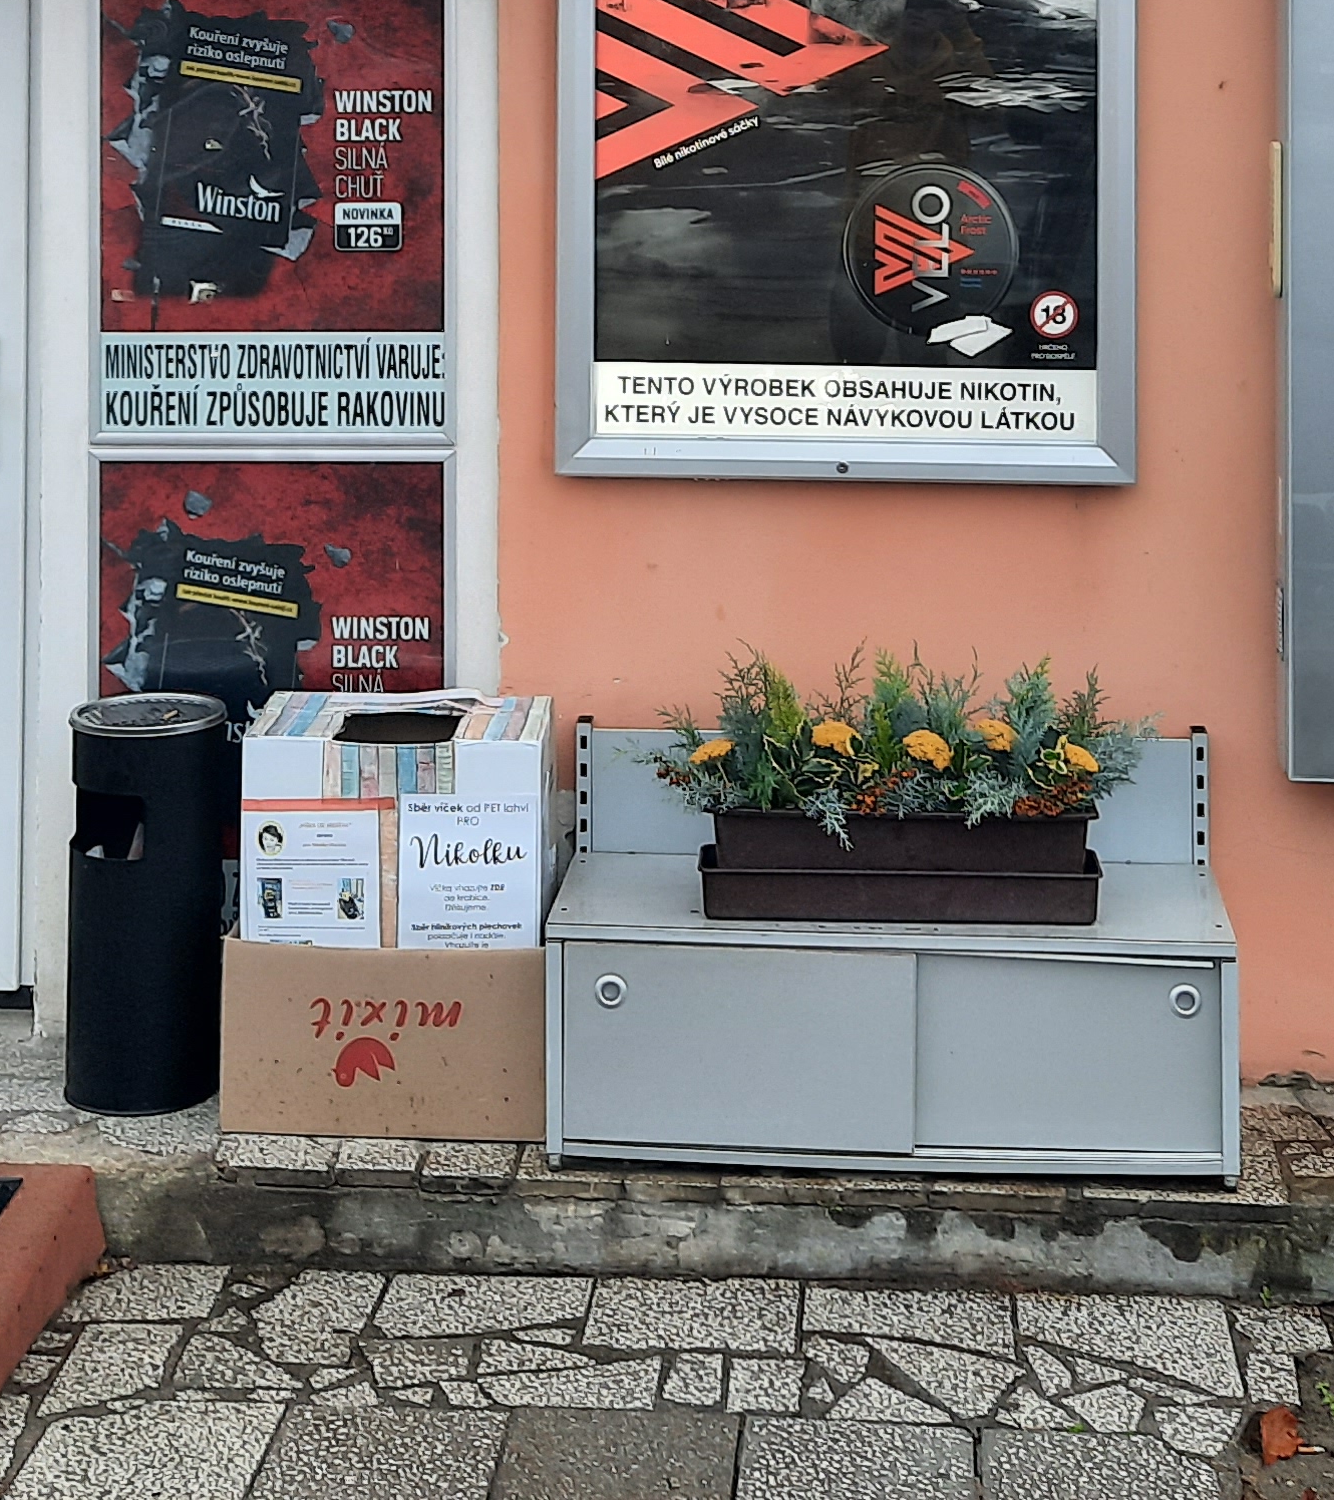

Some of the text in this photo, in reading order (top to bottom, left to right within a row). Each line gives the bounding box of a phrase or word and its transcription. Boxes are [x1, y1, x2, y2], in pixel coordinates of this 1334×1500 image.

[335, 90, 433, 113] WINSTON
[336, 118, 402, 142] BLACK
[335, 142, 388, 170] SILNÁ
[675, 127, 728, 160] nikotinové
[335, 174, 384, 199] CHUŤ
[197, 181, 280, 223] Winston
[342, 207, 394, 220] NOVINKA
[347, 226, 383, 248] 126
[1040, 304, 1067, 325] 18
[105, 337, 445, 380] MINISTERSTVO ZDRAVOTNICTVÍ VARUJE:
[617, 373, 1062, 404] TENTO VÝROBEK OBSAHUJE NIKOTIN,
[106, 382, 445, 427] KOUŘENÍ ZPŮSOBUJE RAKOVINU
[604, 399, 1075, 432] KTERÝ JE VYSOCE NÁVYKOVOU LÁTKOU
[332, 616, 429, 640] WINSTON
[332, 645, 399, 668] BLACK
[456, 816, 479, 826] PRO
[409, 833, 528, 869] Nikolku
[310, 997, 463, 1042] mixit
